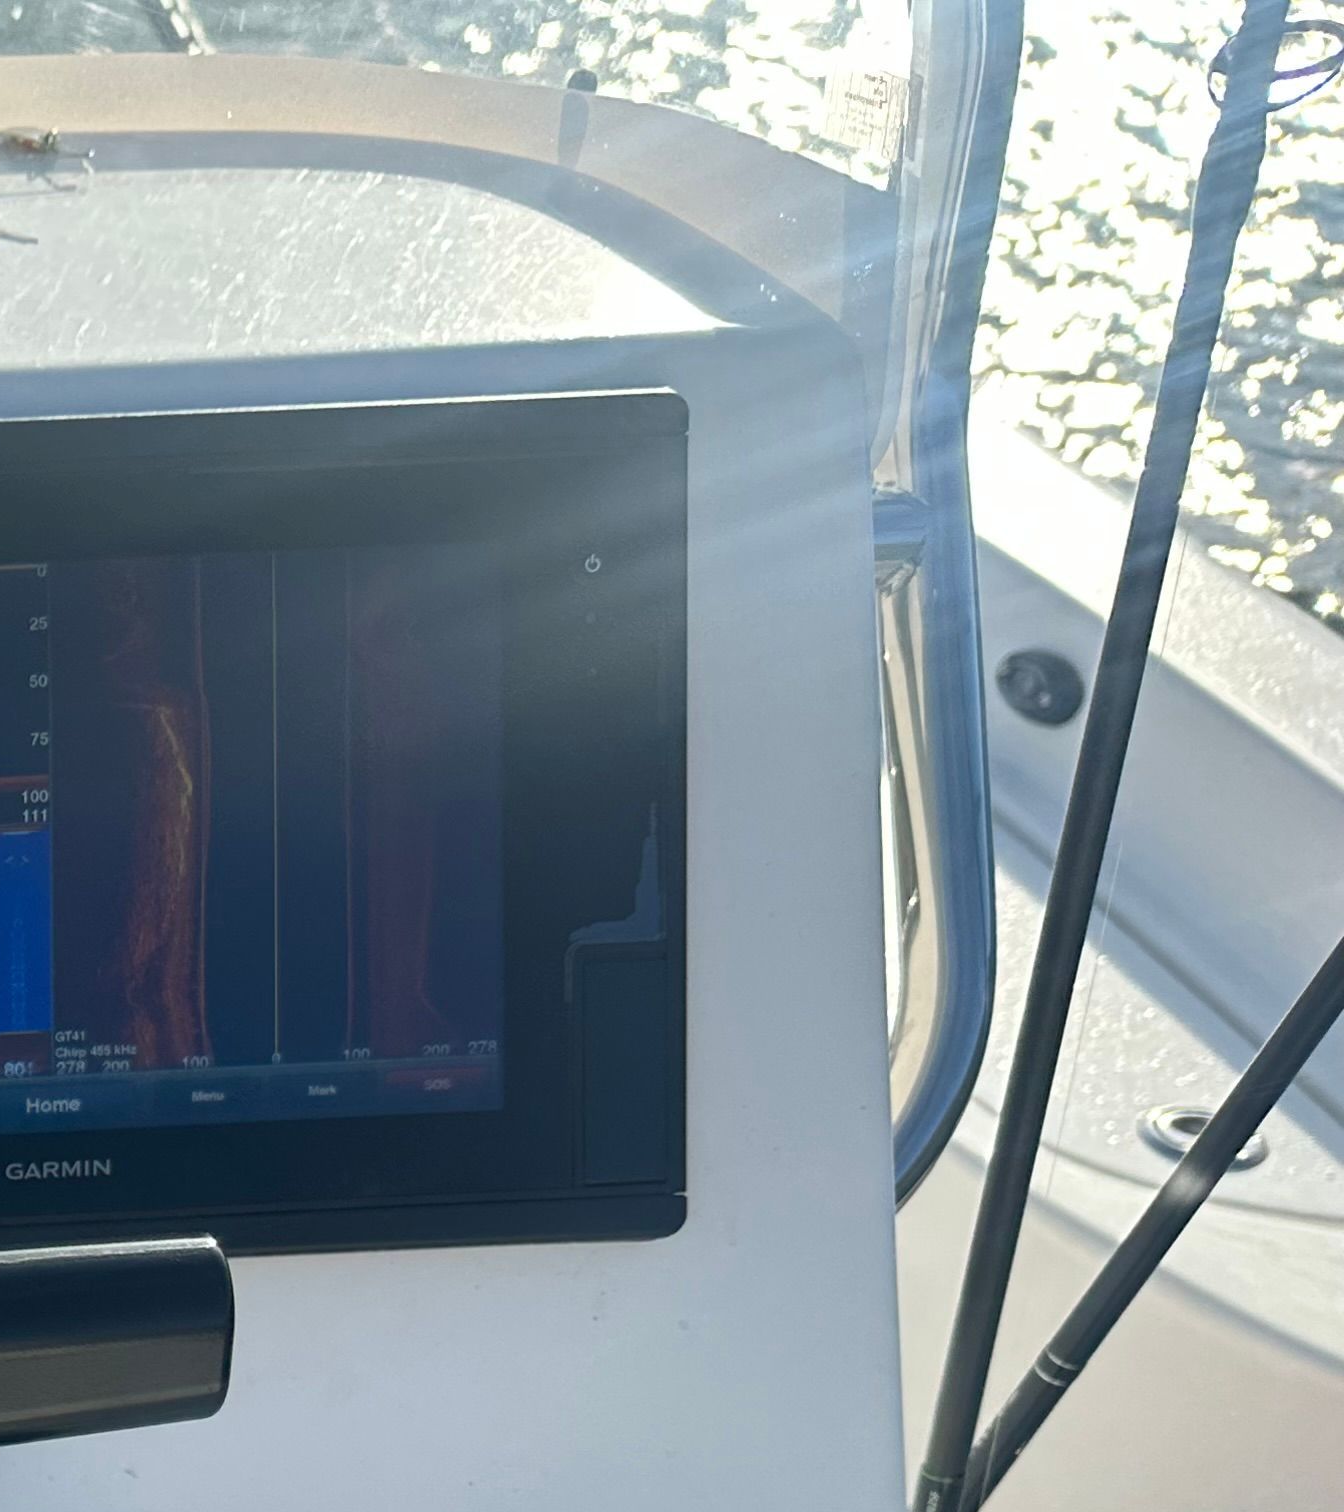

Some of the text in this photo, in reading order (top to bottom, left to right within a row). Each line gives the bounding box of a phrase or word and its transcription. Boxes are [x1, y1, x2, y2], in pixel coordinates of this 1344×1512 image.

[36, 564, 48, 578] 0
[29, 616, 48, 631] 25
[29, 674, 48, 689] 50
[30, 732, 49, 747] 75
[21, 789, 48, 804] 100
[23, 809, 48, 824] 111
[55, 1031, 85, 1043] GT41
[55, 1045, 137, 1059] Chirp 455 kHz
[183, 1056, 209, 1069] 100
[26, 1097, 81, 1113] Home
[5, 1159, 112, 1181] GARMIN
